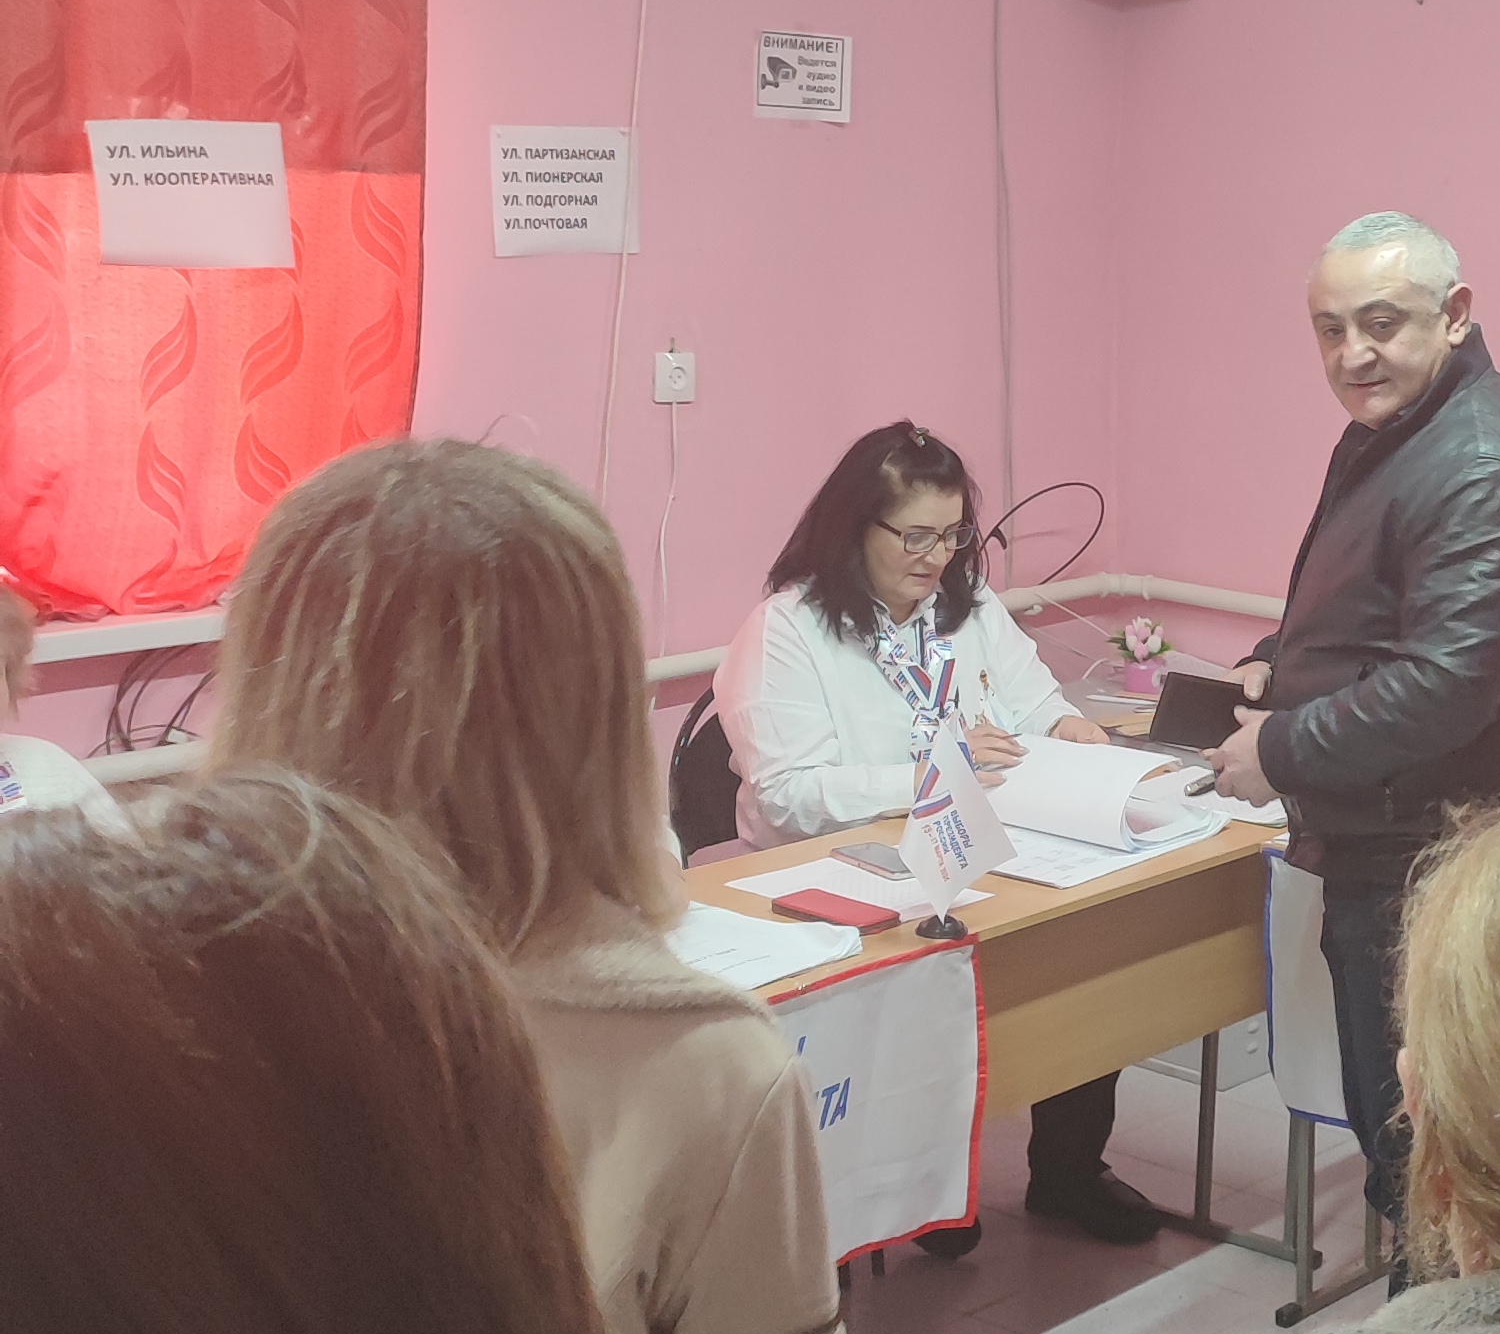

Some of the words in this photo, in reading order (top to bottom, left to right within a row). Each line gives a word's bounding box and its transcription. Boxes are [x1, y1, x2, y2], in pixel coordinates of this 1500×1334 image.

[763, 35, 839, 53] ВНИМАНИЕ!
[805, 84, 836, 93] видео
[105, 145, 136, 159] УЛ.
[140, 145, 209, 159] ИЛЬИНА
[501, 148, 522, 160] УЛ.
[525, 148, 616, 161] ПАРТИЗАНСКАЯ
[110, 172, 139, 186] УЛ.
[144, 172, 275, 187] КООПЕРАТИВНАЯ
[502, 171, 522, 183] УЛ.
[526, 171, 603, 184] ПИОНЕРСКАЯ
[502, 194, 523, 207] УЛ.
[526, 194, 598, 208] ПОДГОРНАЯ
[504, 218, 588, 230] УЛ.ПОЧТОВАЯ
[950, 809, 974, 849] ВЫБОРЫ
[942, 815, 969, 870] ПРЕЗИДЕНТА
[816, 1076, 851, 1131] ТА
